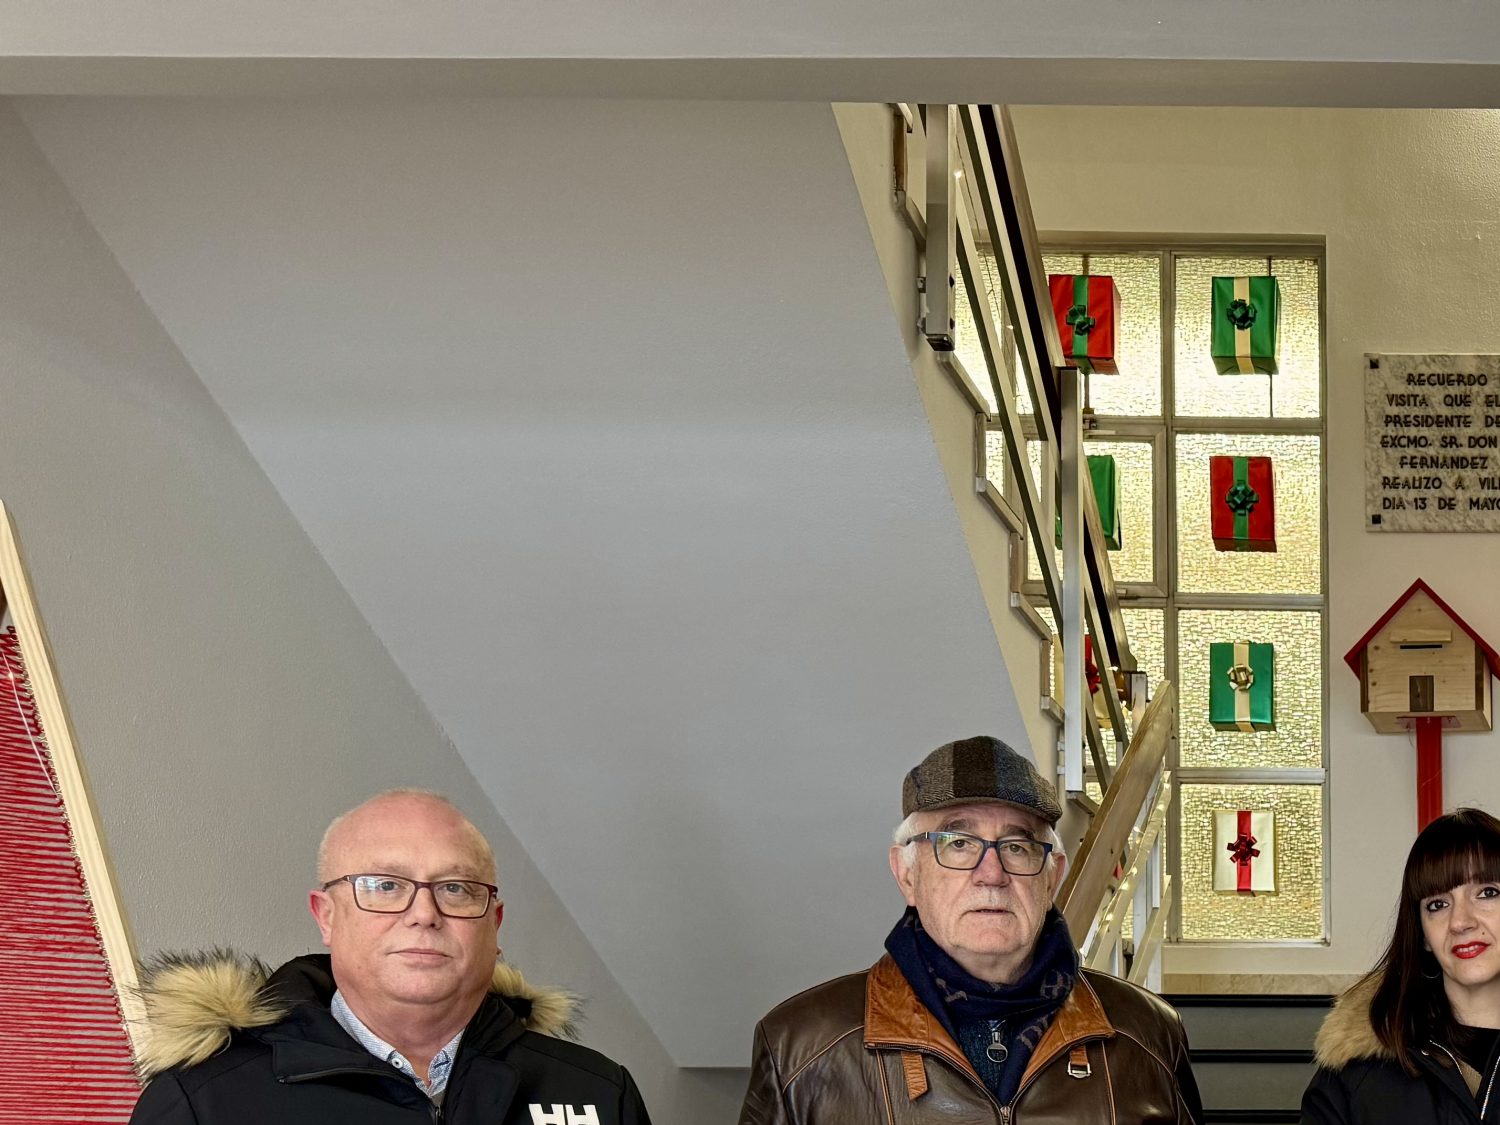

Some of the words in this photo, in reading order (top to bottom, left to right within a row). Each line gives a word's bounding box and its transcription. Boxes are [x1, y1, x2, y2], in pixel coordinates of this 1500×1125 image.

[1406, 374, 1488, 386] RECUERDO
[1387, 394, 1428, 407] VISITA
[1443, 394, 1472, 407] QUE
[1384, 415, 1472, 427] PRESIDENTE
[1380, 436, 1432, 448] EXCMO.
[1440, 436, 1463, 448] SR.
[1468, 436, 1497, 448] DON
[1399, 457, 1488, 469] FERNANDEZ
[1382, 477, 1442, 490] REALIZO
[1455, 478, 1465, 490] A
[1383, 498, 1405, 509] DIA
[1414, 498, 1427, 509] 13
[1438, 498, 1456, 510] DE
